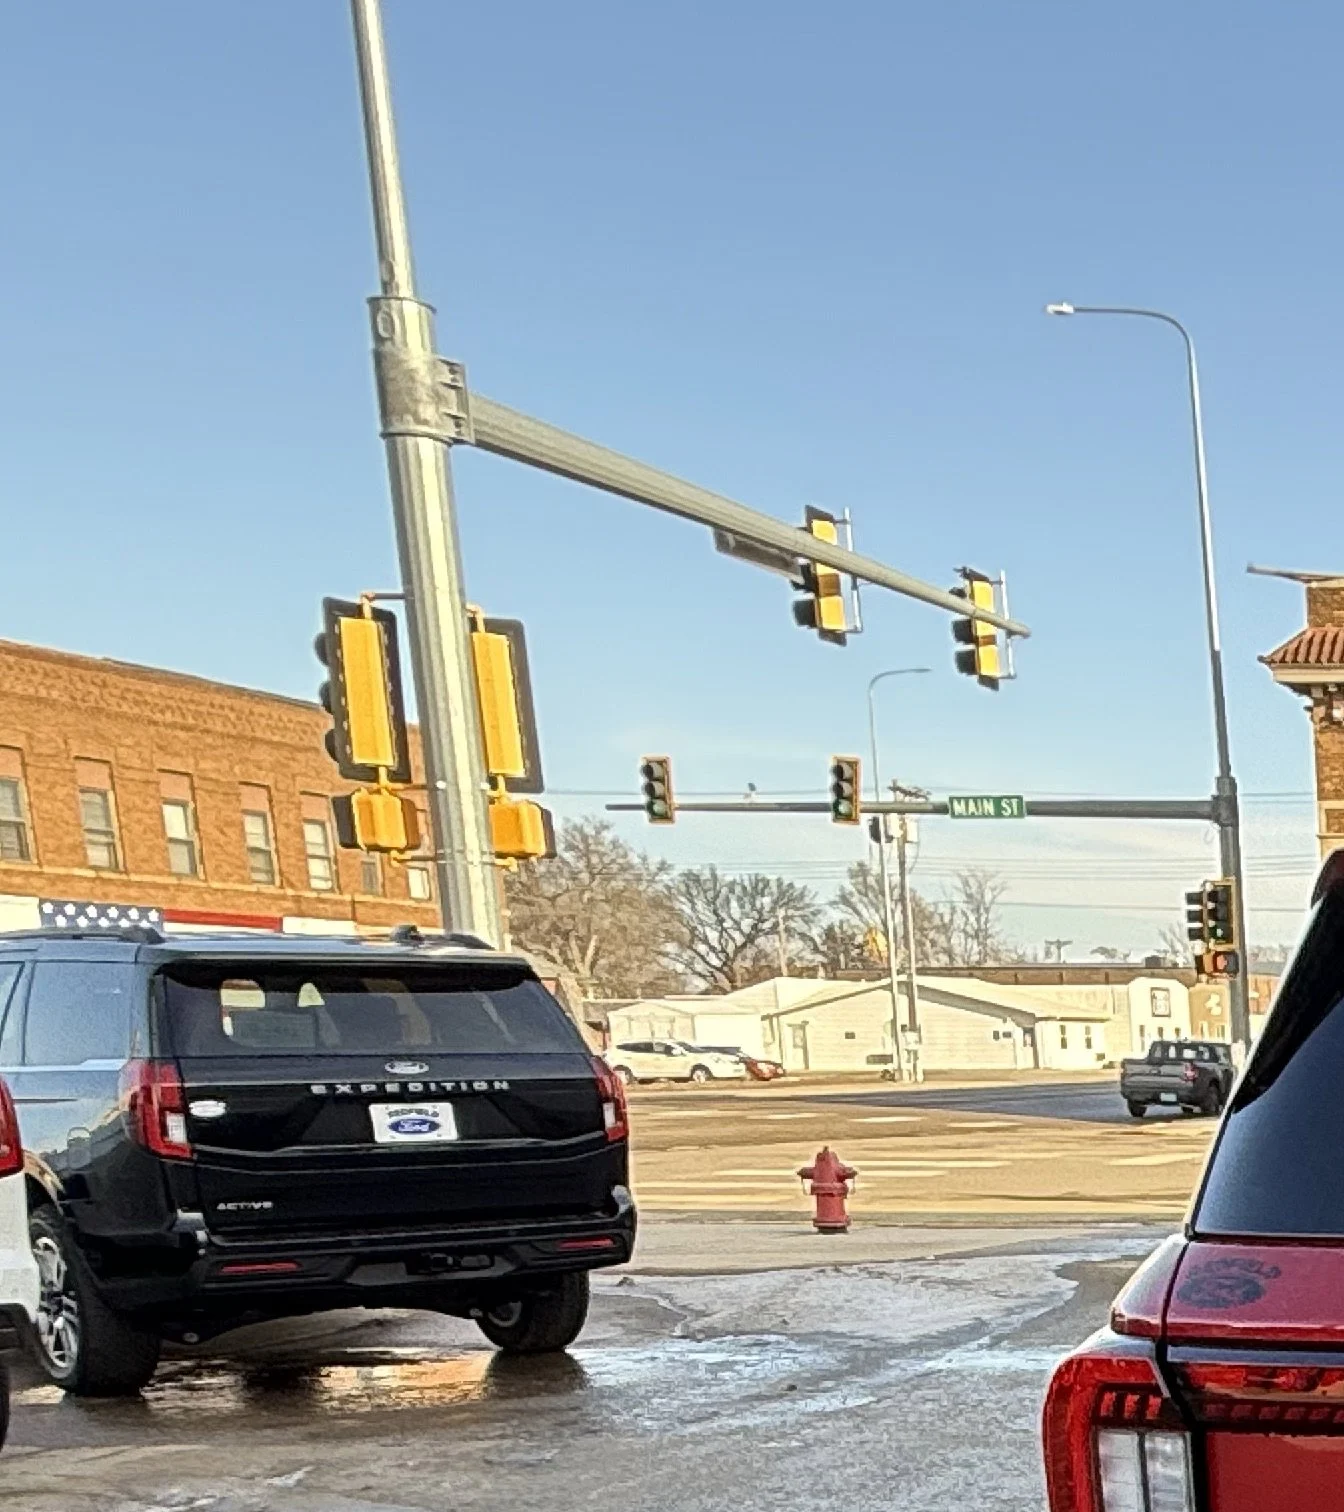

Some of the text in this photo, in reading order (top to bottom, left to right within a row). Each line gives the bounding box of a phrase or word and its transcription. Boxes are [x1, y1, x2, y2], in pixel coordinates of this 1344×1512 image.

[952, 798, 1019, 816] MAIN ST
[310, 1080, 510, 1095] EXPEDITION
[216, 1200, 273, 1210] ACTIVE
